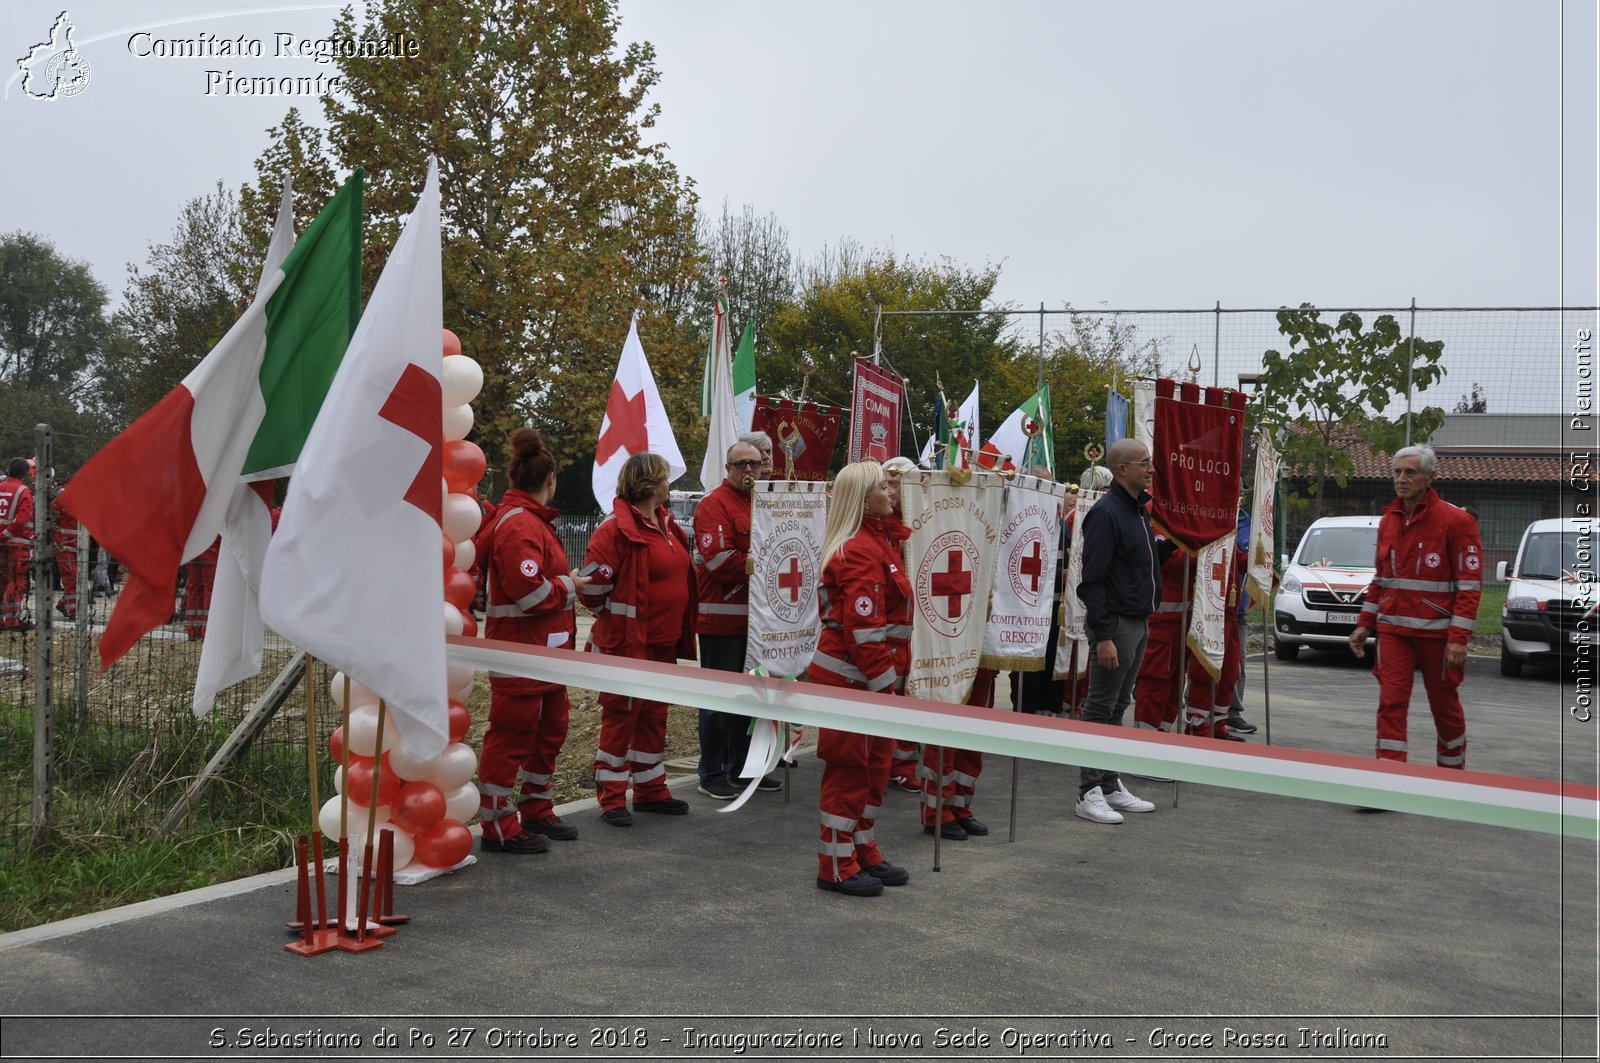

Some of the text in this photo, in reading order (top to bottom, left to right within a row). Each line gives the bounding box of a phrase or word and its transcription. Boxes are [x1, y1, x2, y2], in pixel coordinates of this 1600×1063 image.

[1170, 452, 1230, 476] PRO LOCO
[1195, 480, 1205, 492] DI
[934, 497, 965, 513] ROSSA
[774, 519, 800, 537] ROSS
[1000, 512, 1024, 545] CROCE
[991, 613, 1035, 627] COMITATO
